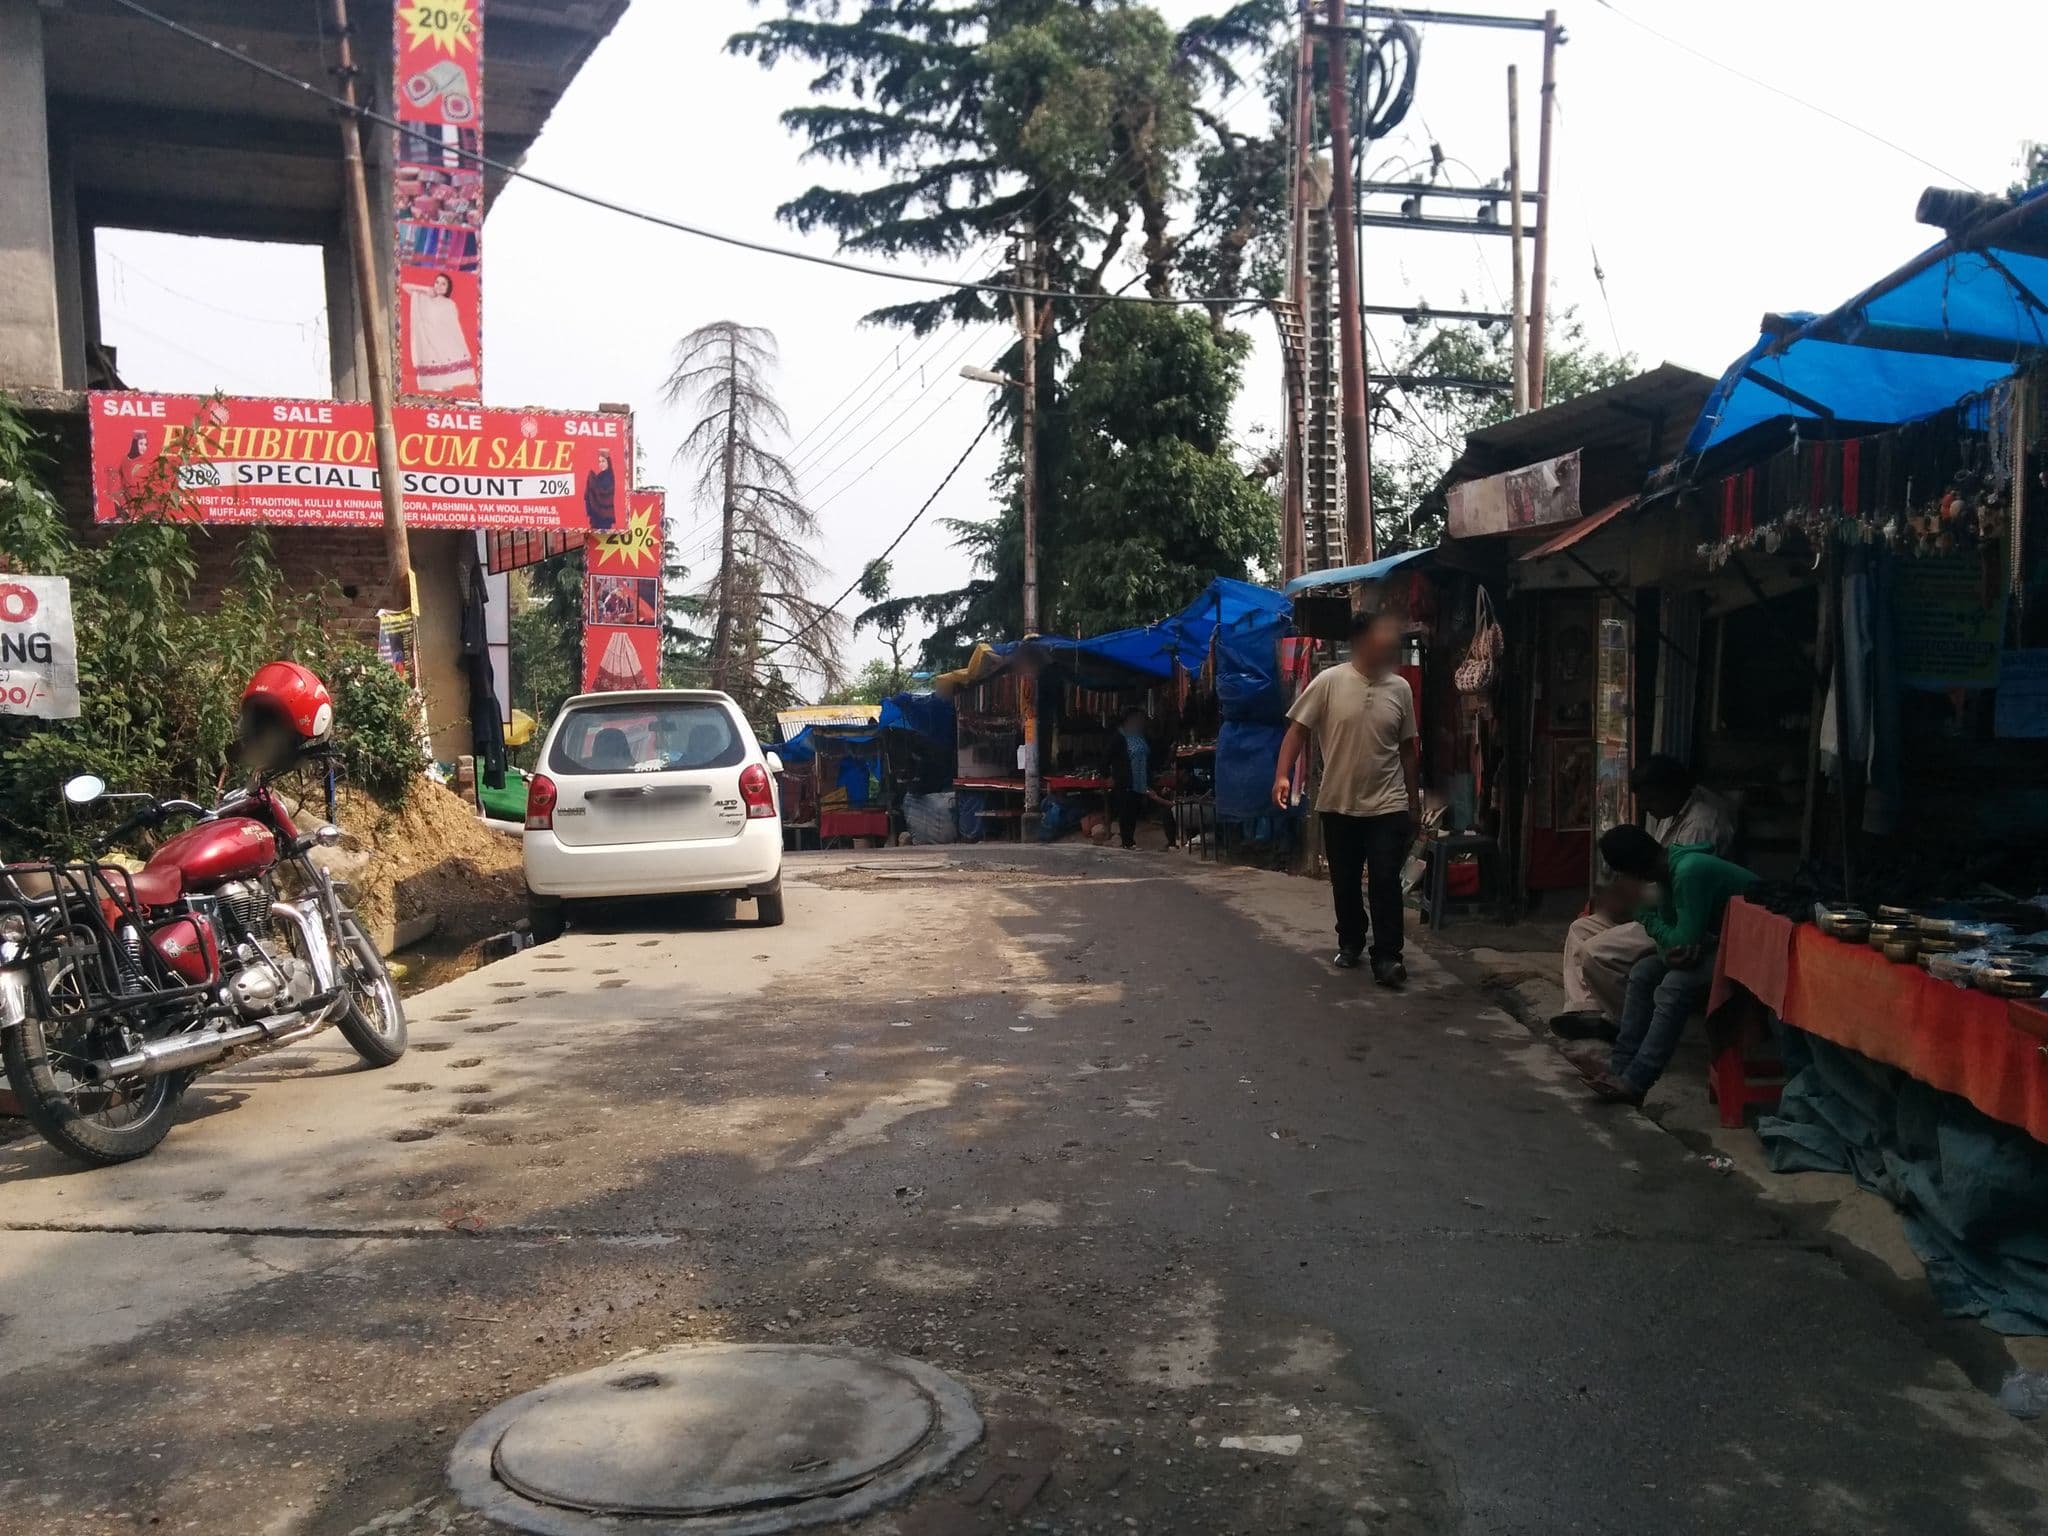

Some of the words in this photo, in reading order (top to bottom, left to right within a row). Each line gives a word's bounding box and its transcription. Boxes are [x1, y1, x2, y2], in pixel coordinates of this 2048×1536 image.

[419, 7, 471, 33] 20%
[104, 400, 166, 417] SALE
[273, 406, 332, 423] SALE
[427, 413, 482, 430] SALE
[564, 420, 617, 437] SALE
[401, 432, 483, 468] CUM
[488, 437, 575, 471] SALE
[185, 469, 220, 486] 20%
[238, 464, 361, 487] SPECIAL
[372, 472, 523, 496] SCOUNT
[539, 479, 570, 496] 20%
[196, 496, 219, 505] VISIT
[250, 497, 301, 508] TRADITIONL
[304, 498, 334, 508] KULLU
[336, 498, 342, 508] &
[403, 501, 430, 512] GORA,
[432, 502, 477, 513] PASHMINA,
[478, 503, 494, 513] YAK
[496, 504, 521, 514] WOOL
[523, 505, 559, 515] SHAWLS,
[298, 509, 324, 520] CAPS,
[326, 510, 368, 521] JACKETS,
[421, 512, 468, 522] HANDLOOM
[470, 514, 476, 523] &
[478, 514, 534, 524] HANDICRAFTS
[536, 515, 560, 525] ITEMS
